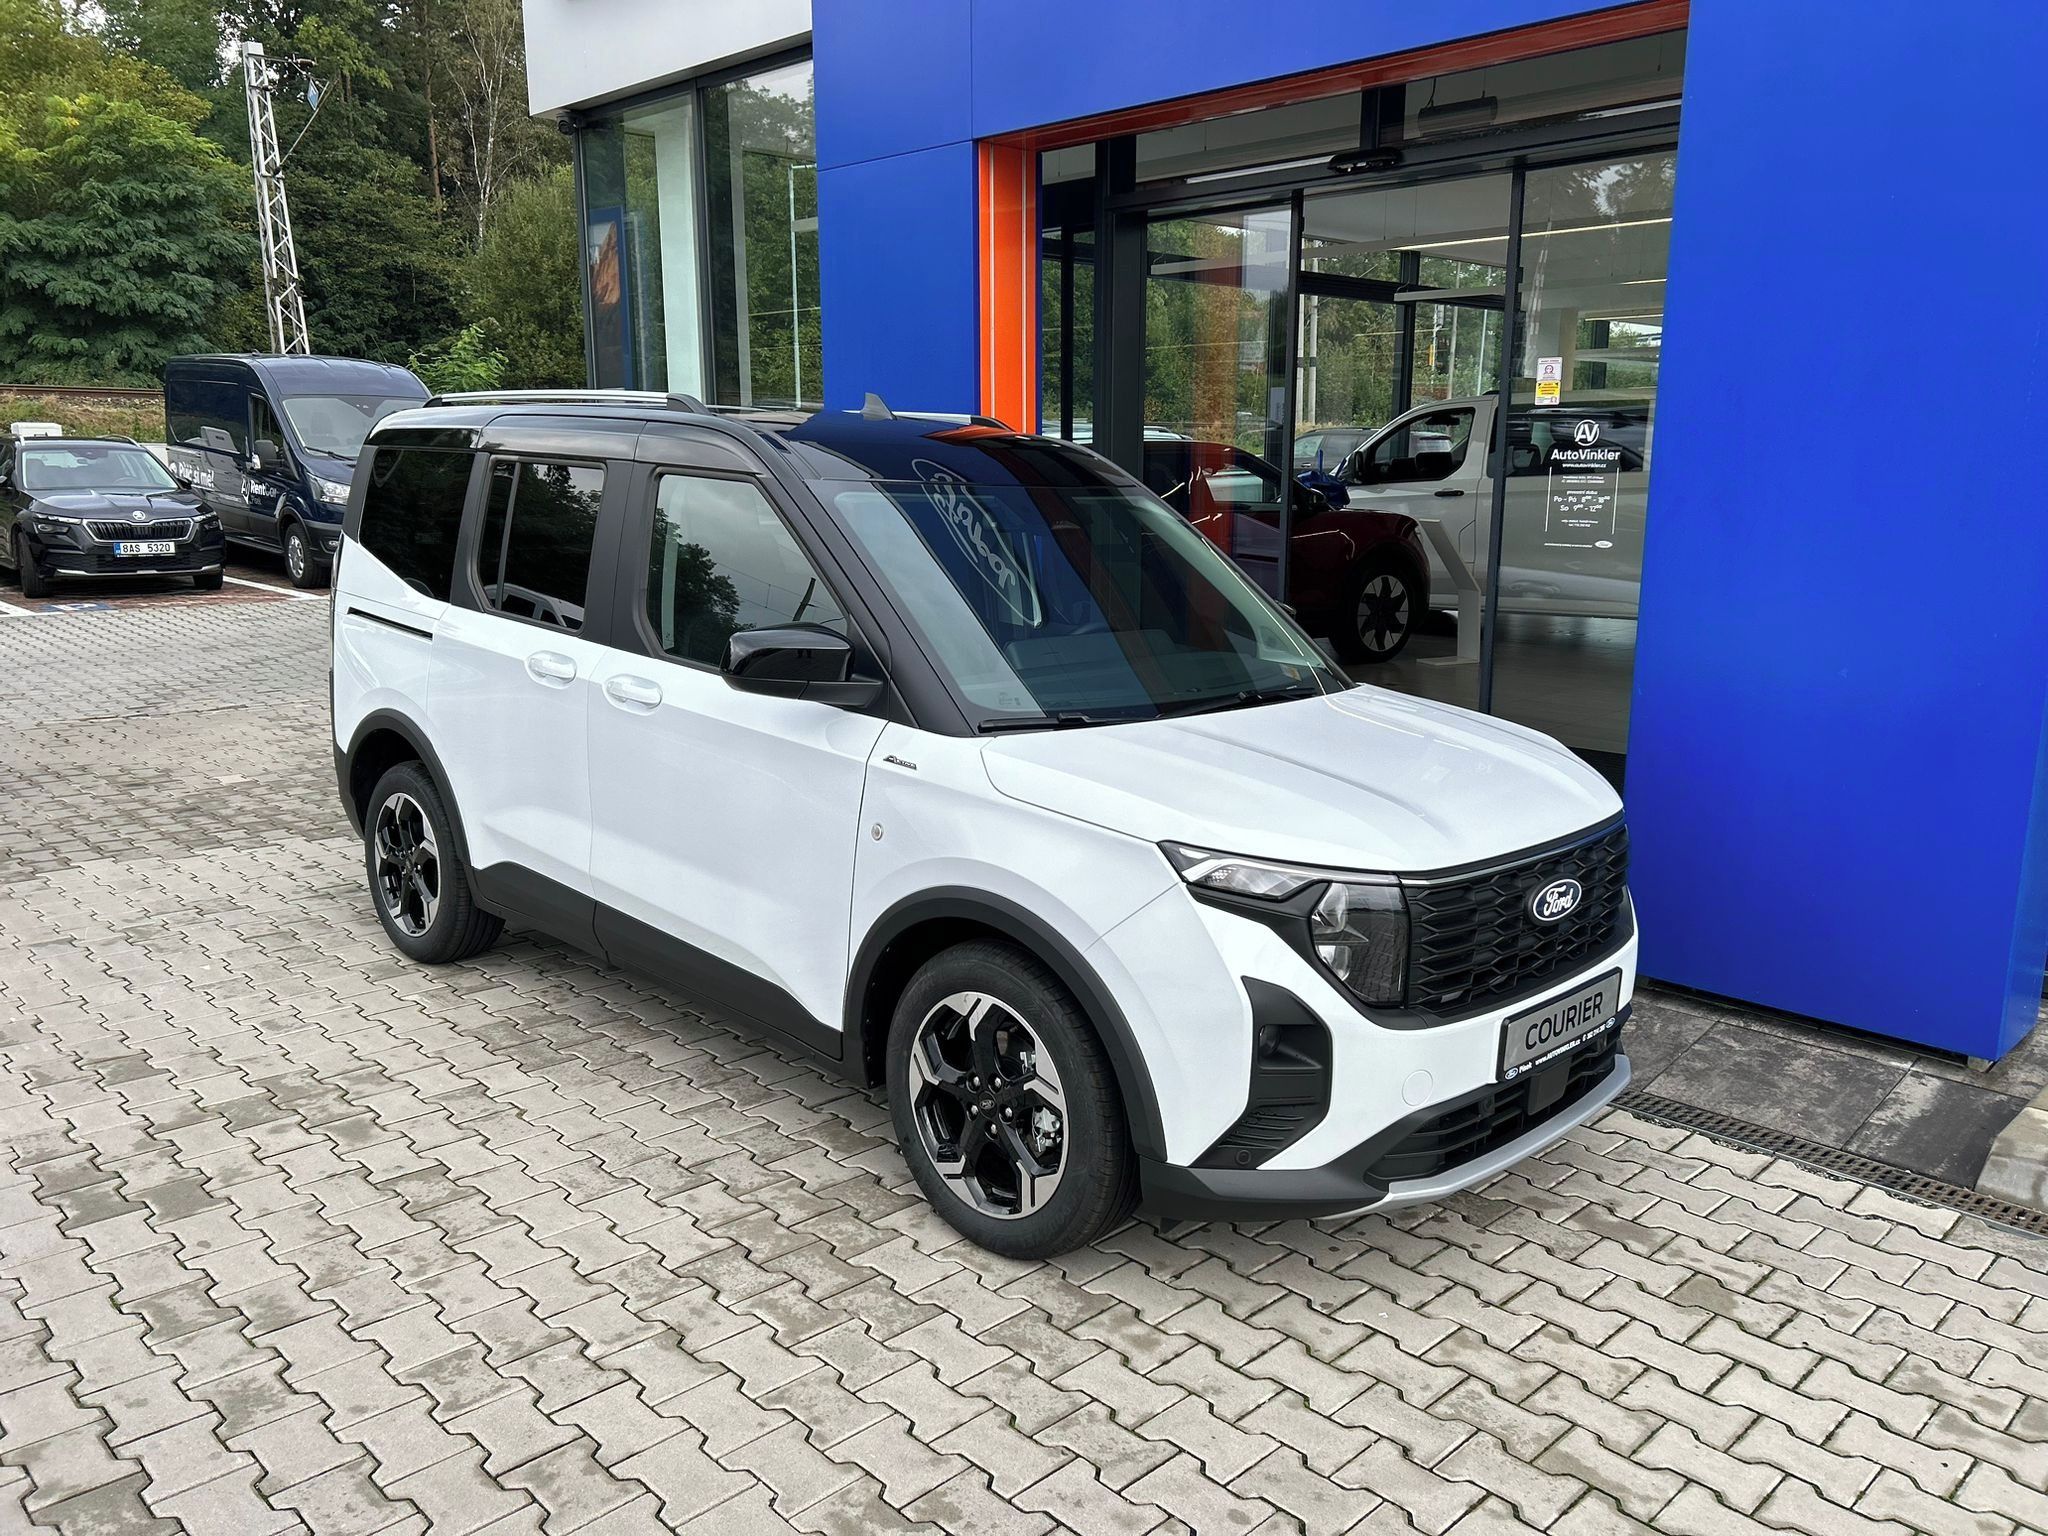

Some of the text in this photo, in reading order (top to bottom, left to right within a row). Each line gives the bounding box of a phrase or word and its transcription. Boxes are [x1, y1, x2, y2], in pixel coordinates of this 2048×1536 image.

[1550, 448, 1621, 460] AutoVinkler
[122, 544, 141, 553] 8AS
[147, 543, 171, 552] 5320
[1543, 885, 1573, 917] Ford
[1525, 991, 1604, 1051] COURIER
